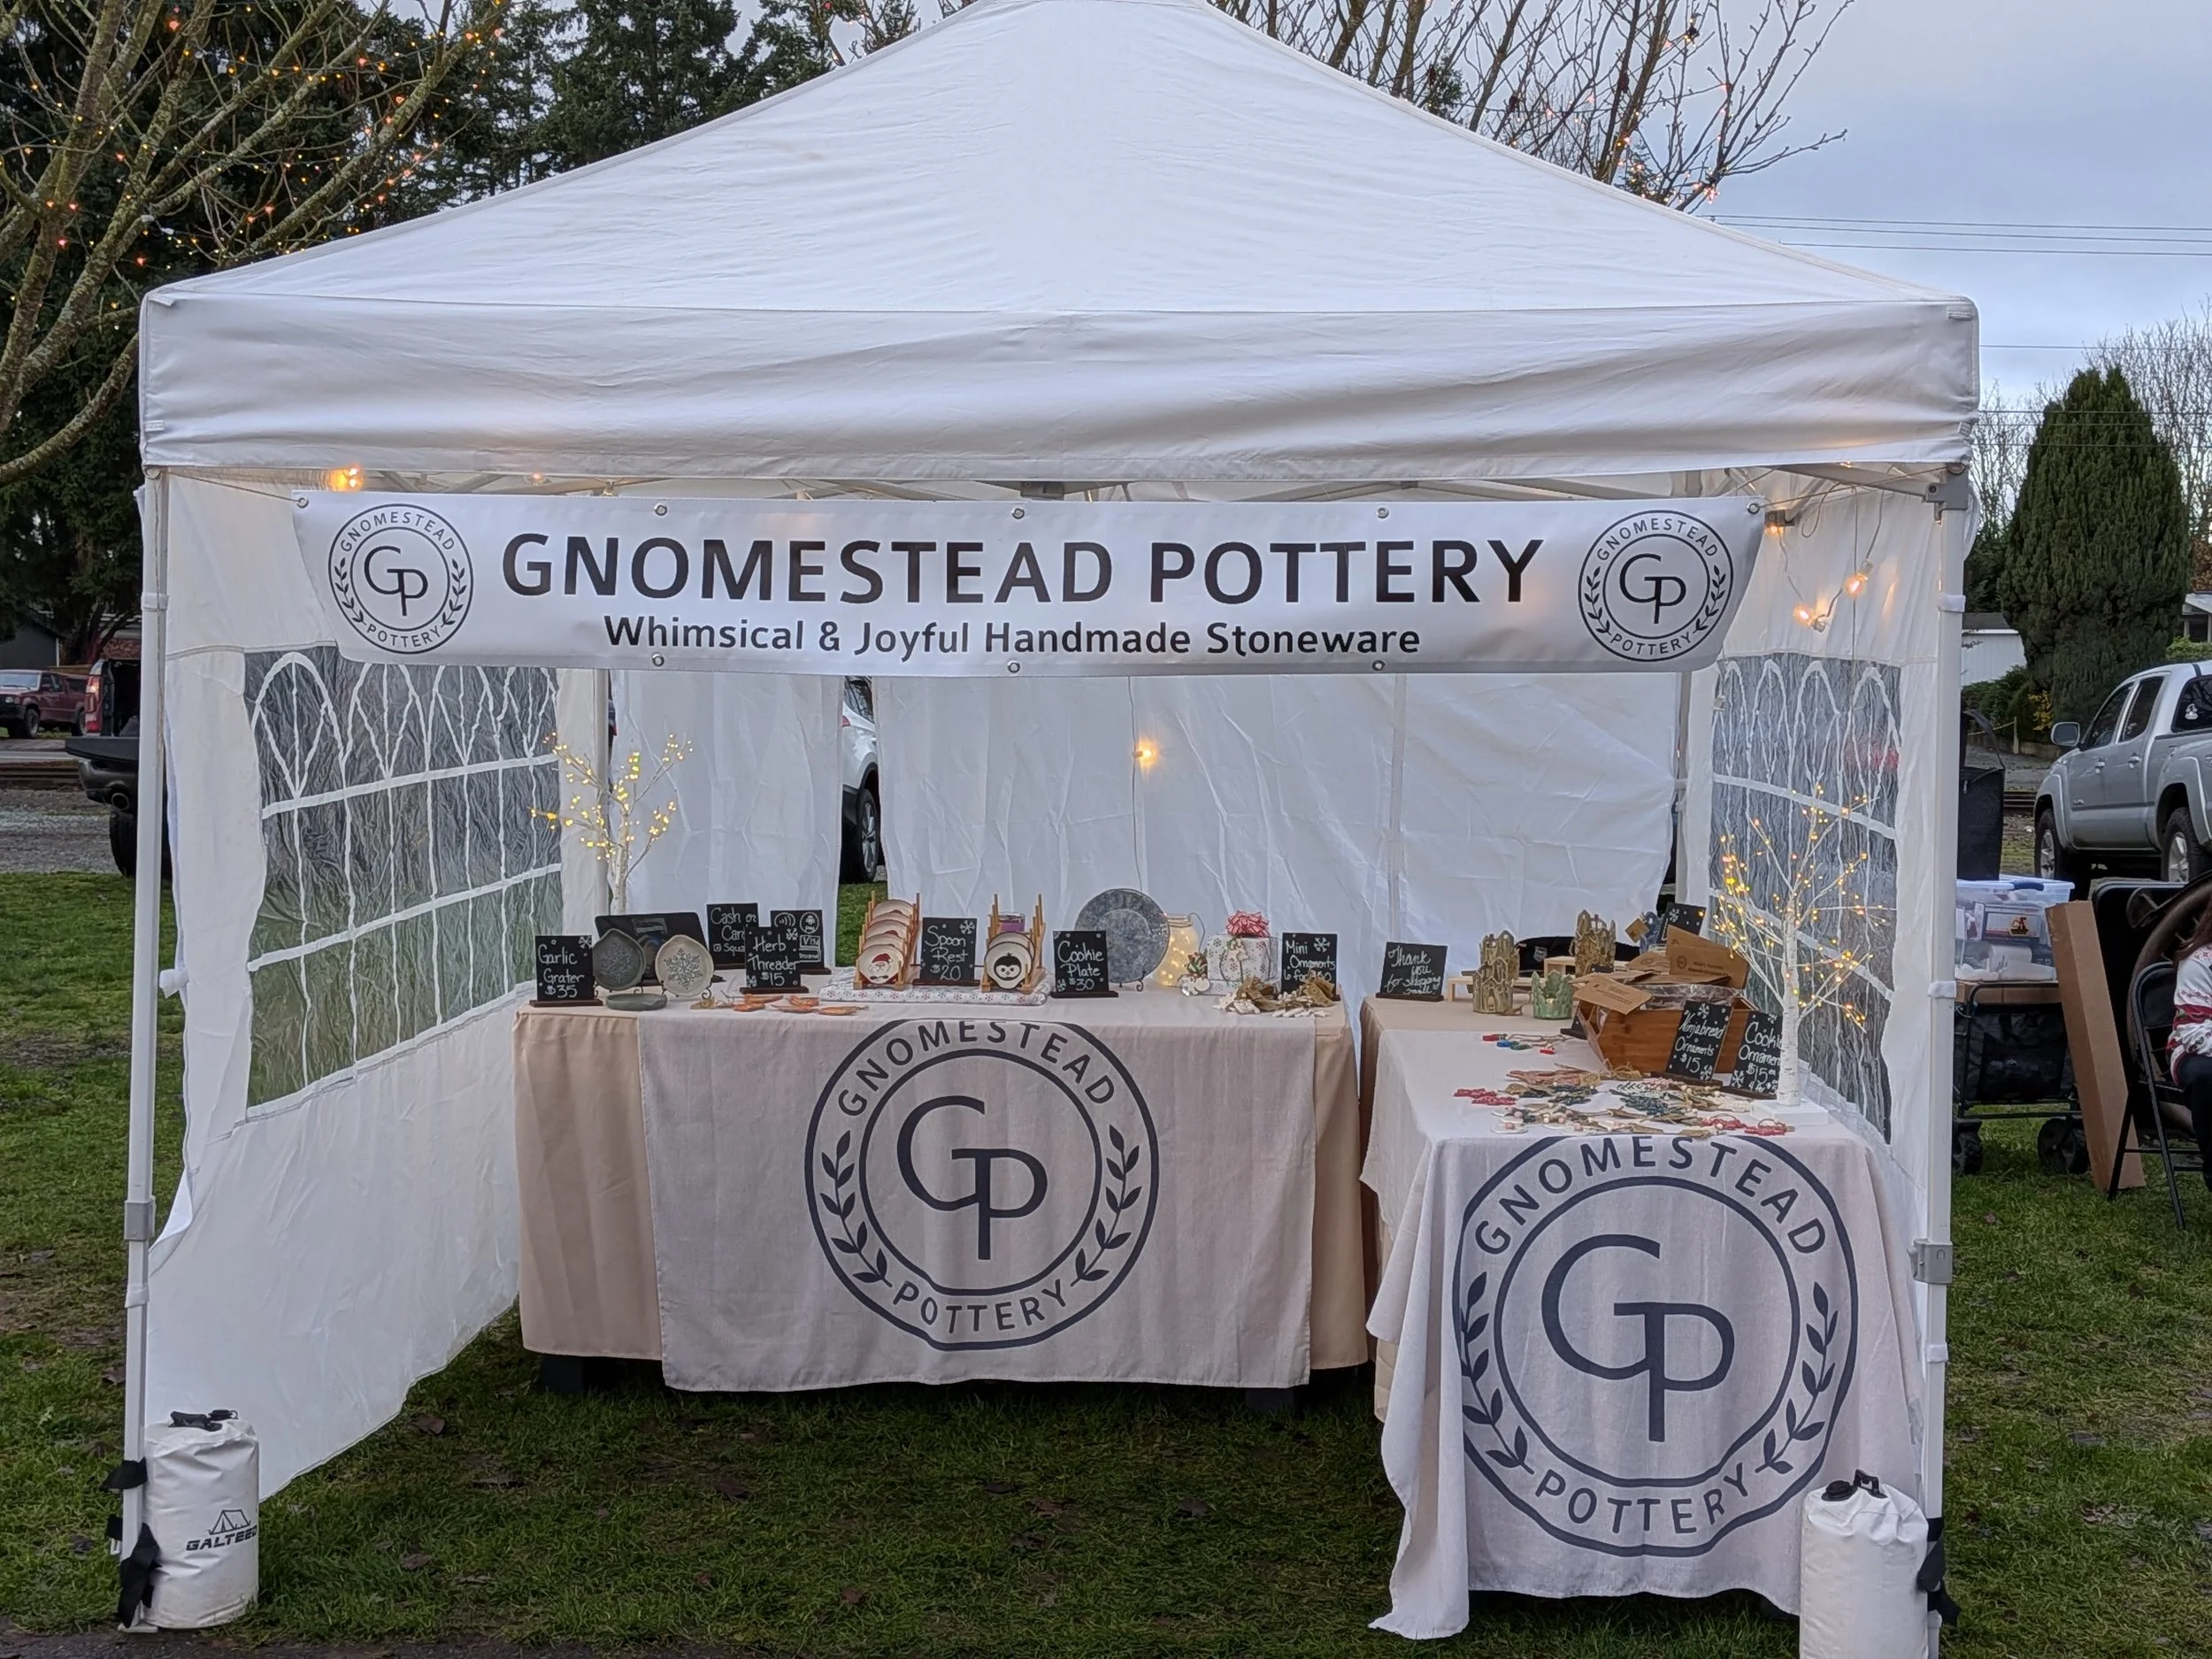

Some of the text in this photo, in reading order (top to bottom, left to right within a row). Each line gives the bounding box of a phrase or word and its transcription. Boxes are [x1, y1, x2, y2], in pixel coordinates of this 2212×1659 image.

[340, 511, 455, 552] GNOMESTEAD
[1596, 518, 1718, 561] GNOMESTEAD
[502, 533, 1544, 604] GNOMESTEAD POTTERY
[366, 623, 442, 649] POTTERY
[603, 616, 1420, 662] Whimsical & Joyful Handmade Stoneware
[1610, 631, 1692, 655] POTTERY
[710, 906, 757, 925] Cash or
[721, 925, 745, 941] Car
[752, 933, 787, 952] Herb
[924, 926, 965, 949] Spoon
[538, 943, 578, 964] Garlic
[724, 943, 745, 956] Squa
[930, 947, 968, 965] Rest
[1057, 941, 1104, 963] Cookie
[1285, 940, 1308, 955] Mini
[1387, 945, 1432, 967] Thank
[747, 954, 800, 971] Threader
[930, 964, 962, 981] $20
[1060, 963, 1101, 977] Plate
[1289, 955, 1336, 971] Ornaments
[543, 968, 585, 984] Grater
[761, 972, 785, 987] $15
[1069, 978, 1094, 991] $30
[1384, 973, 1403, 993] for
[545, 985, 578, 998] $35
[1675, 1036, 1715, 1056] Ornaments
[1739, 1044, 1780, 1066] Ornamen
[838, 1020, 1115, 1117] GNOMESTEAD
[1680, 1053, 1701, 1073] $15
[1746, 1063, 1768, 1085] $15
[1475, 1135, 1825, 1255] GNOMESTEAD
[893, 1279, 1066, 1334] POTTERY
[1535, 1463, 1748, 1534] POTTERY
